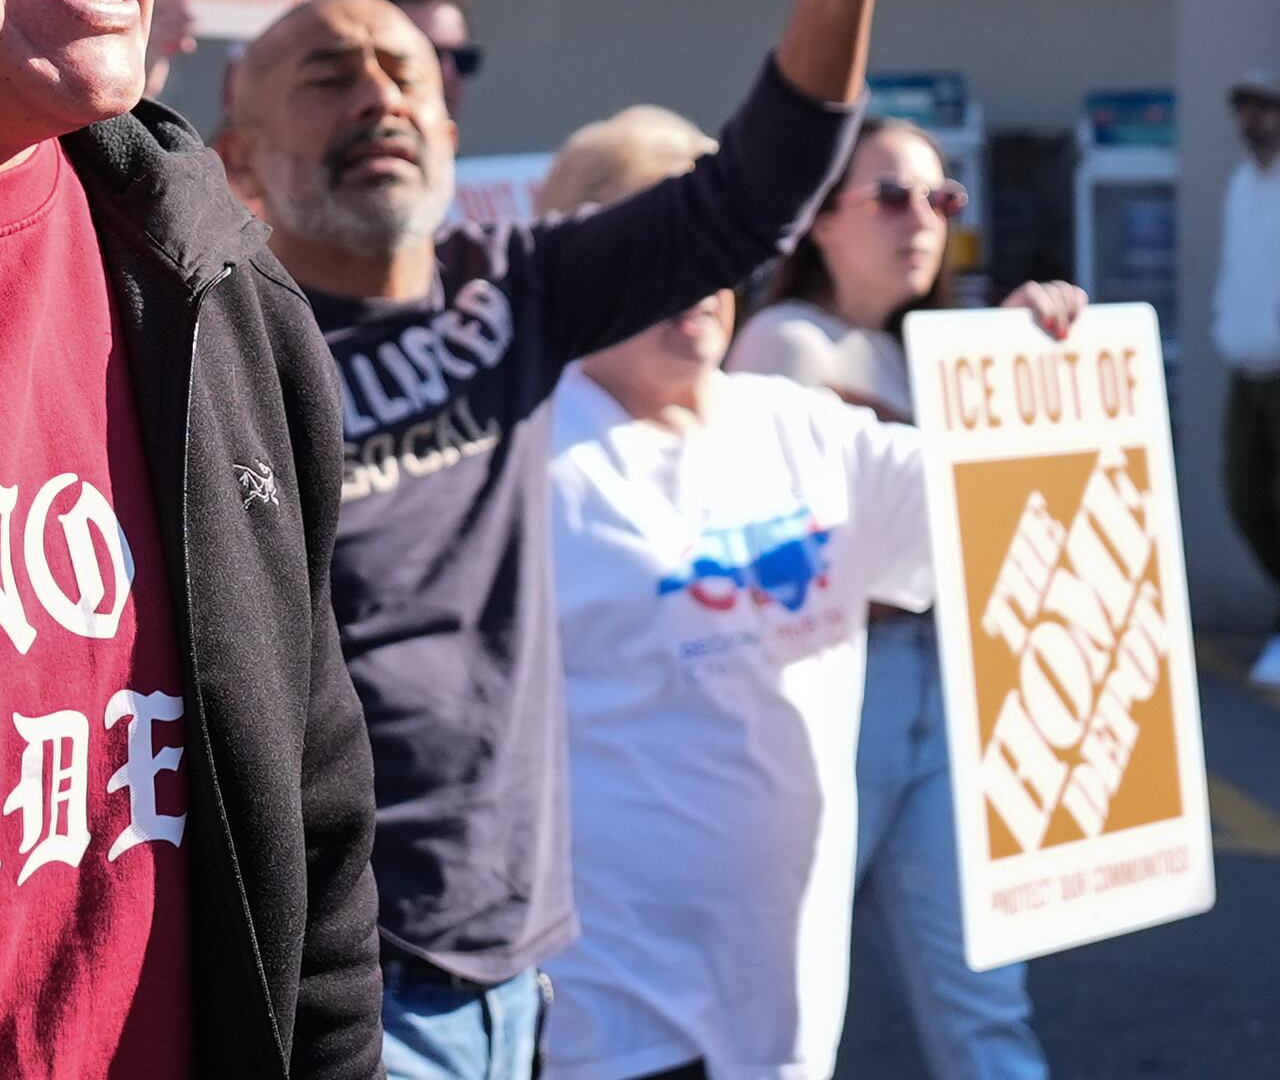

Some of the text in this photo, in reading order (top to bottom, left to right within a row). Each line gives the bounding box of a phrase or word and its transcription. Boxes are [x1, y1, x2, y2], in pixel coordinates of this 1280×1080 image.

[940, 348, 1138, 429] ICE OUT OF
[978, 448, 1154, 851] HOME
[981, 489, 1067, 656] THE
[1063, 580, 1170, 838] DEPOT
